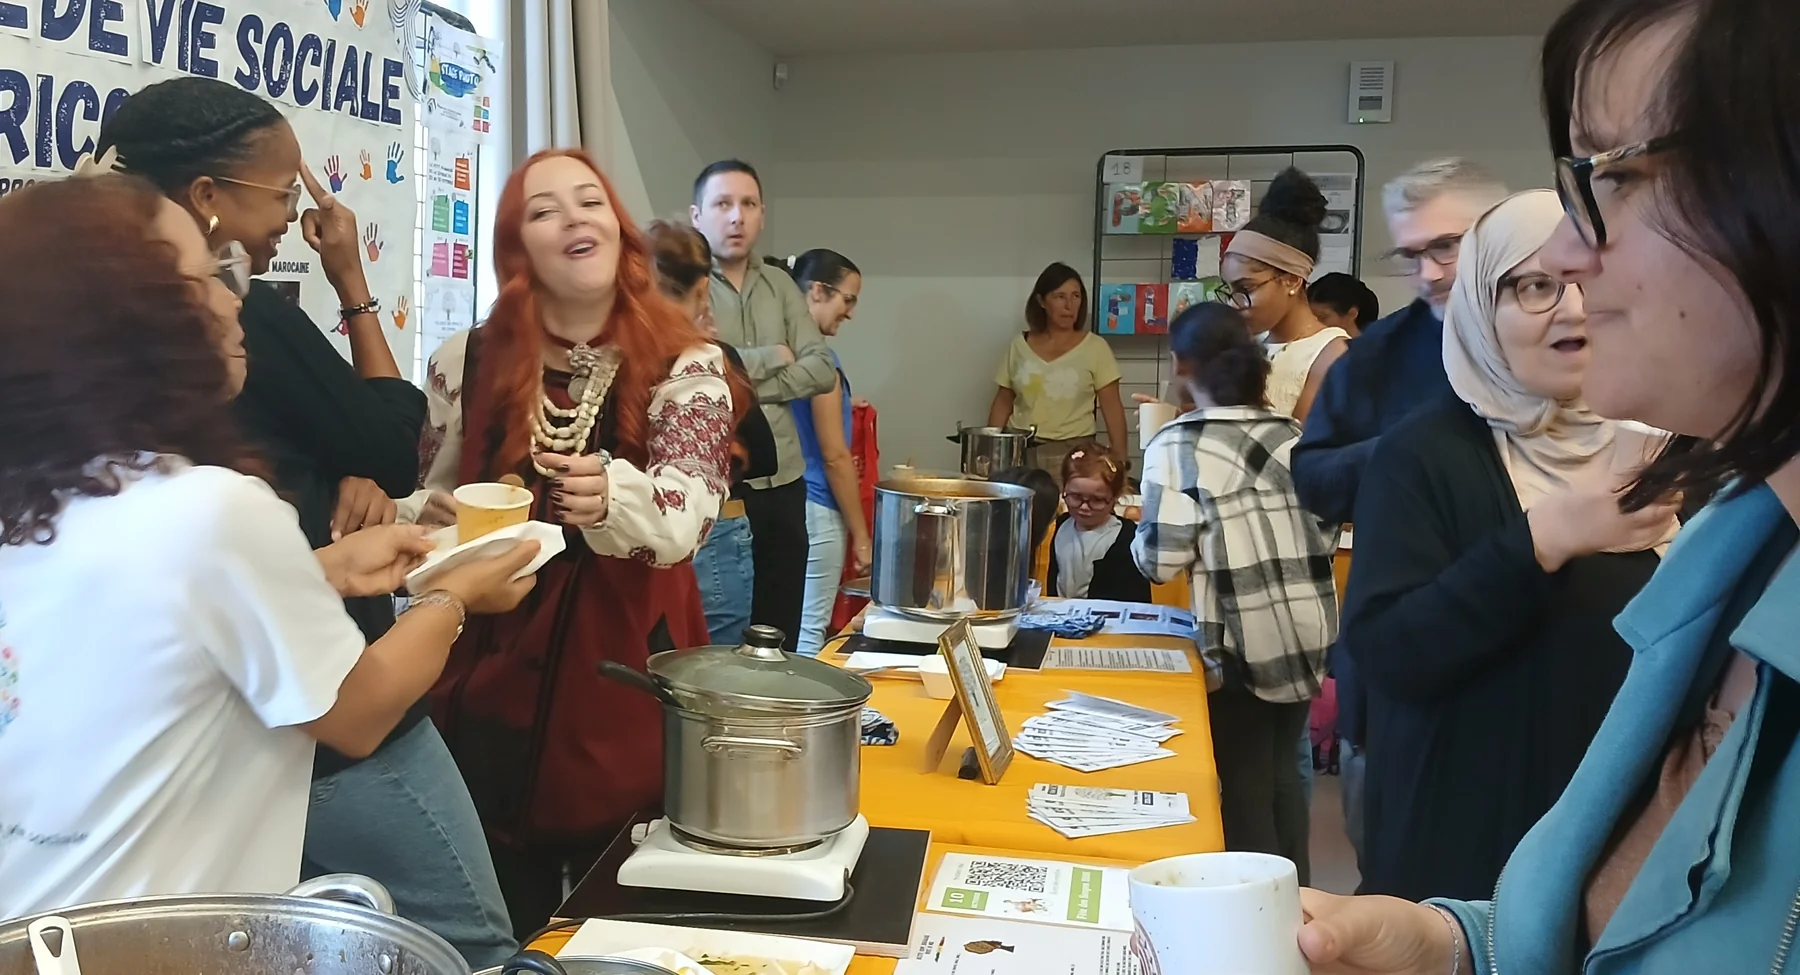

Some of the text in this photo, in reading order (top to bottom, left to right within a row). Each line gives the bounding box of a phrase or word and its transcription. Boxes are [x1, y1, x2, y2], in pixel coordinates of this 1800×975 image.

[41, 0, 404, 126] DE VIE SOCIALE
[1112, 161, 1131, 176] 18
[271, 260, 310, 274] MAROCAINE
[949, 892, 964, 904] 10
